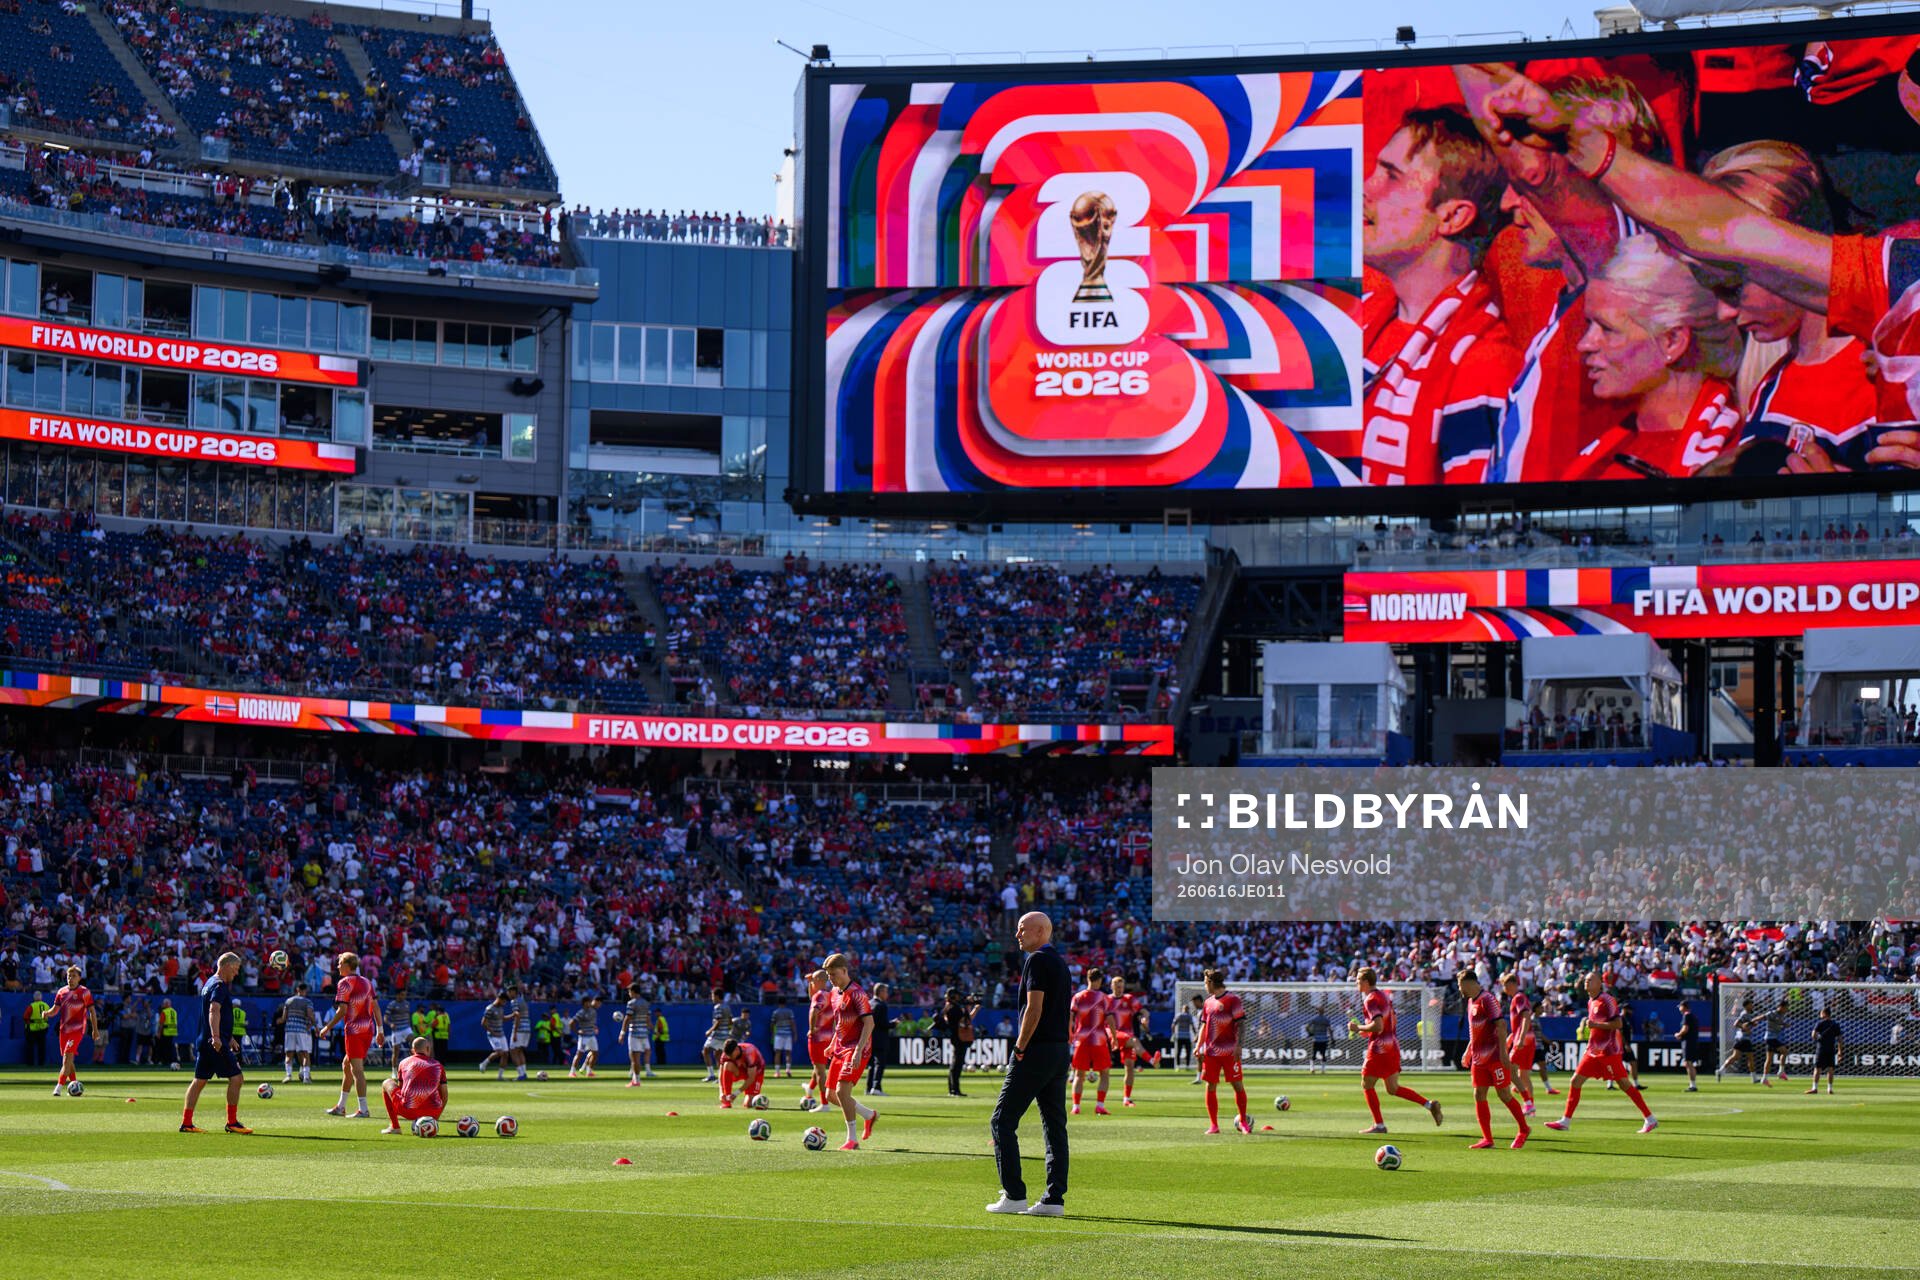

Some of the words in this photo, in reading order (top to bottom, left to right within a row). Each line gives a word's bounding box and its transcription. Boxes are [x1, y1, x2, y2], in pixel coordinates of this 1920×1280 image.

[1069, 311, 1119, 328] FIFA
[32, 325, 76, 349] FIFA
[79, 332, 153, 359] WORLD
[157, 343, 200, 364] CUP
[203, 349, 278, 373] 2026
[1035, 352, 1107, 369] WORLD
[1109, 351, 1150, 367] CUP
[1035, 370, 1150, 397] 2026
[29, 417, 73, 439] FIFA
[76, 424, 151, 449] WORLD
[155, 433, 198, 454] CUP
[200, 438, 276, 461] 2026
[1370, 592, 1468, 622] NORWAY
[1634, 588, 1708, 616] FIFA
[1713, 584, 1842, 614] WORLD
[1848, 582, 1920, 612] CUP
[238, 697, 302, 723] NORWAY
[588, 718, 638, 740] FIFA
[642, 721, 729, 744] WORLD
[732, 724, 781, 745] CUP
[784, 726, 870, 747] 2026
[899, 1038, 925, 1066] NO
[943, 1038, 1008, 1066] RCISM
